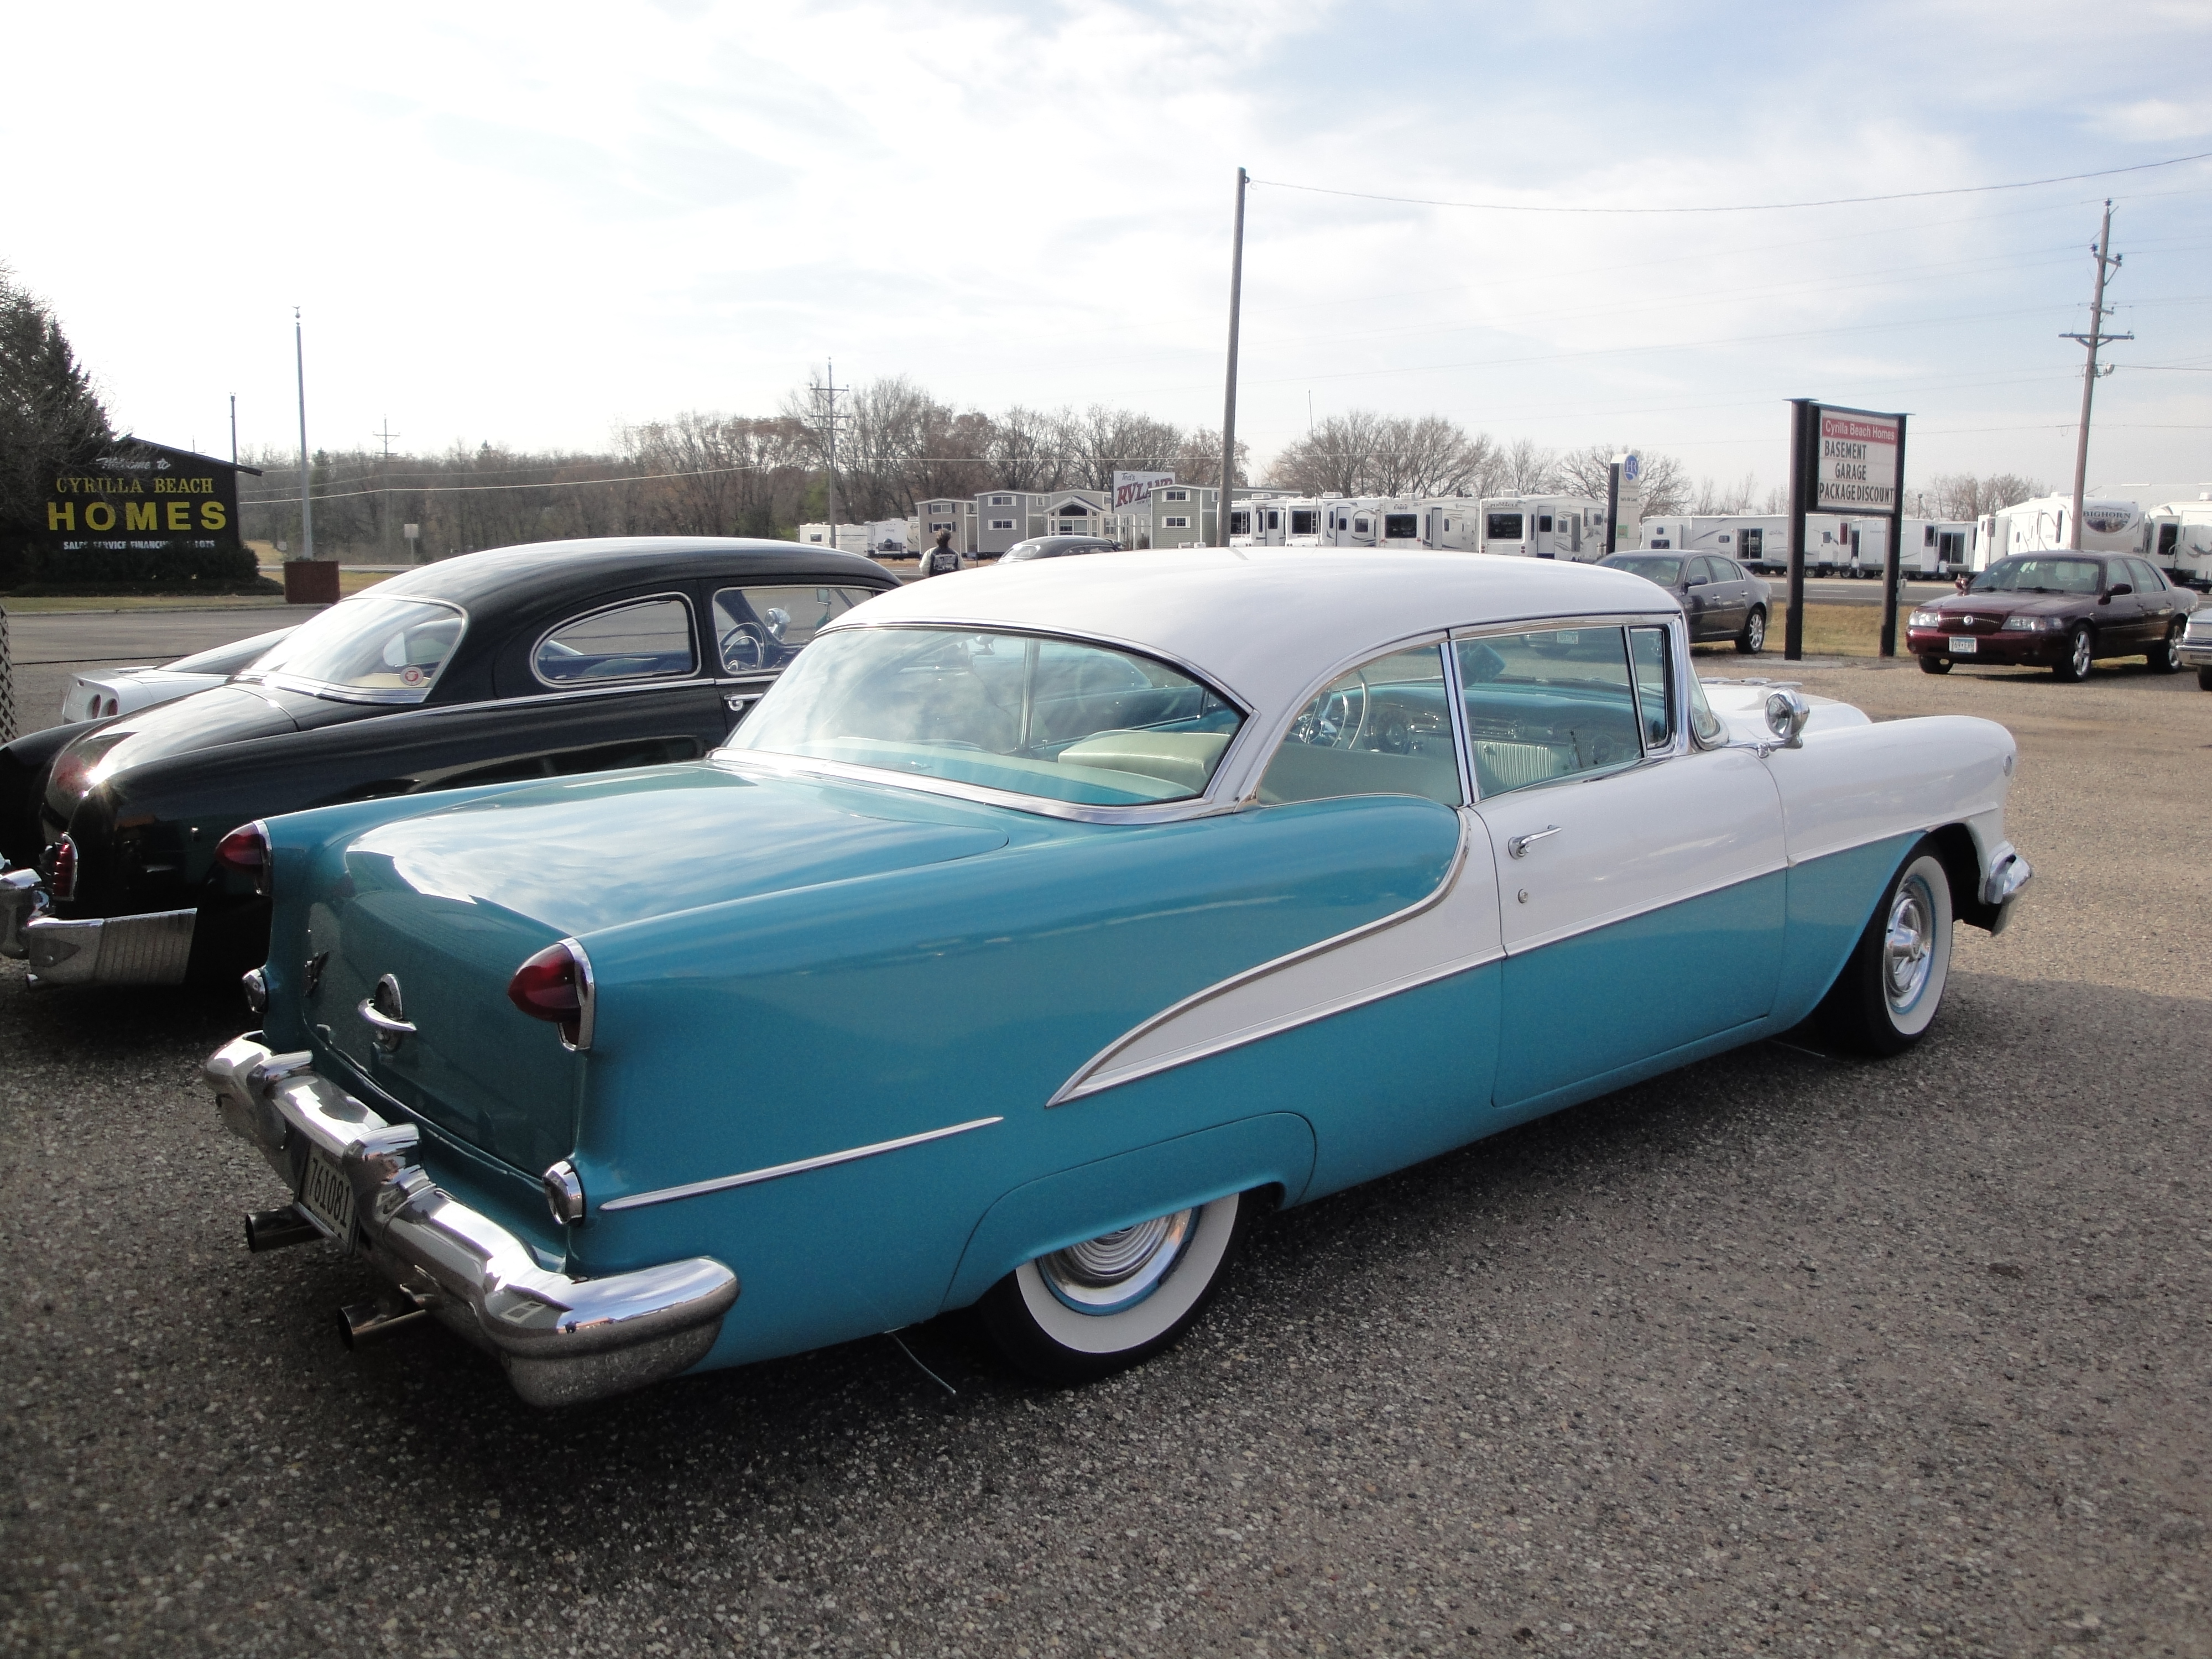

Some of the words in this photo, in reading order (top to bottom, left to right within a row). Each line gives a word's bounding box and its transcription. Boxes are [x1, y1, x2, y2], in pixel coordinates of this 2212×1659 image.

[1825, 419, 1848, 436] Cyrilla
[1850, 424, 1871, 437] Beach
[1872, 426, 1895, 441] Homes
[1824, 440, 1867, 460] BASEMENT
[156, 458, 171, 469] to
[1626, 461, 1637, 472] HR
[1835, 462, 1866, 481] GARAGE
[56, 477, 144, 493] CYRILLA
[154, 478, 214, 493] BEACH
[1121, 472, 1135, 481] Ted's
[1819, 482, 1855, 501] PACKAGE
[1857, 486, 1895, 503] DISCOUNT
[48, 501, 227, 530] HOMES
[2083, 510, 2131, 519] BIGHORN
[309, 1157, 350, 1228] 761081
